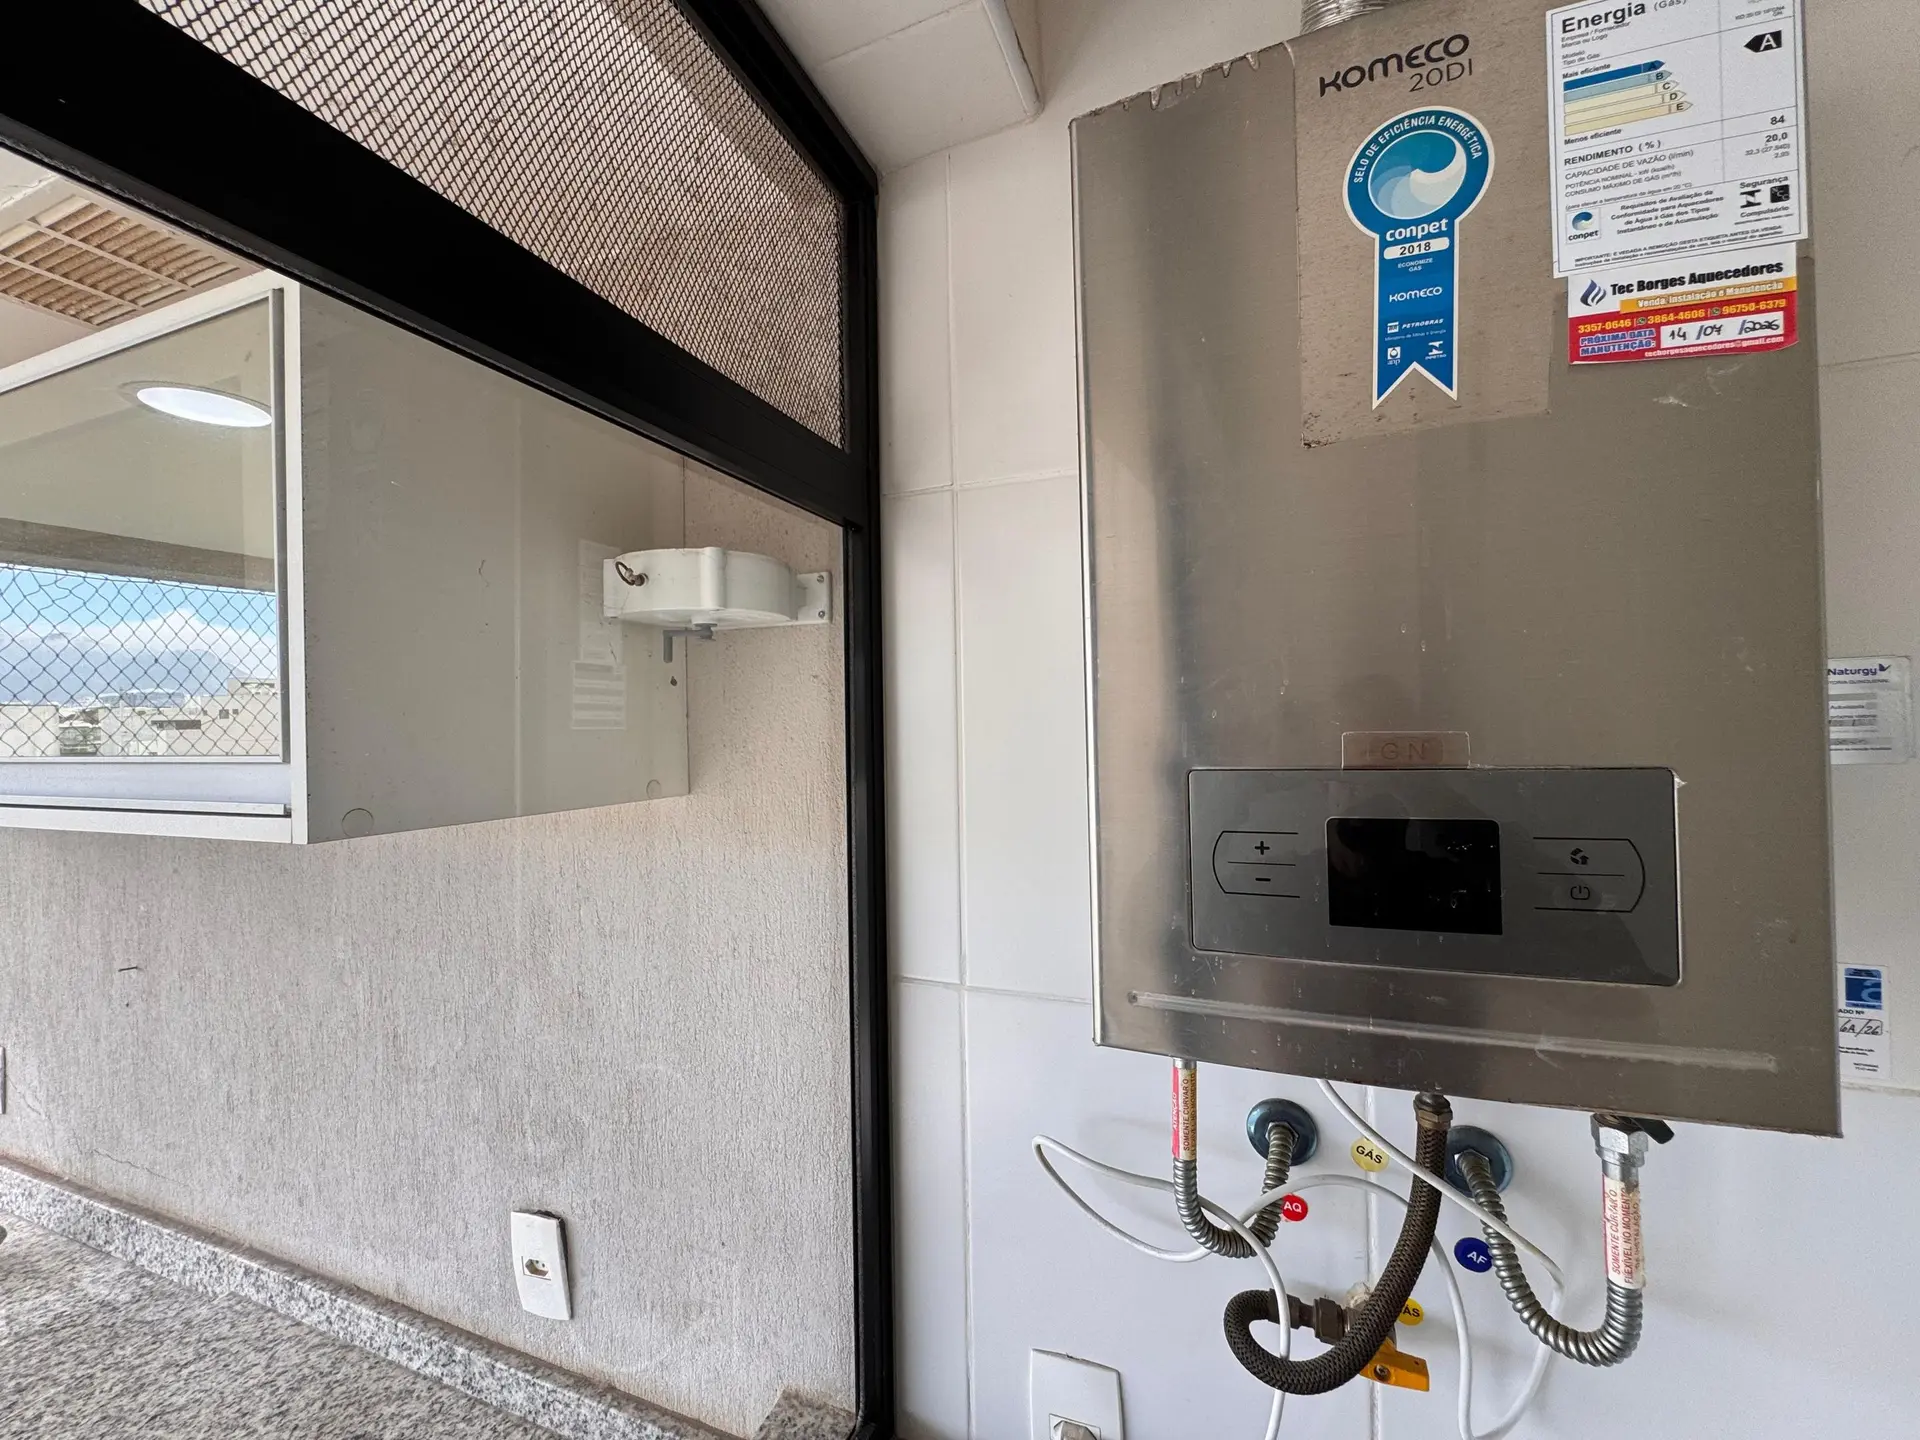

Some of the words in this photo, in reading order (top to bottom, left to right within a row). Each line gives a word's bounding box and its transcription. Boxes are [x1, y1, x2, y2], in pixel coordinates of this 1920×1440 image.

[1562, 3, 1646, 34] Energia
[1592, 33, 1608, 42] Logo
[1759, 34, 1777, 51] A
[1319, 34, 1470, 97] KOMECO
[1562, 70, 1579, 79] Mais
[1580, 63, 1611, 76] eficiente
[1409, 58, 1473, 92] 20DI
[1656, 72, 1664, 80] B
[1662, 82, 1671, 90] C
[1669, 92, 1678, 101] D
[1676, 103, 1684, 111] E
[1770, 115, 1785, 125] 84
[1564, 134, 1589, 145] Menos
[1590, 128, 1621, 140] eficiente
[1354, 159, 1369, 183] SELO
[1366, 143, 1380, 159] DE
[1378, 115, 1436, 144] EFICIÊNCIA
[1438, 116, 1483, 159] ENERGÉTICA
[1564, 145, 1633, 166] RENDIMENTO
[1565, 164, 1620, 180] CAPACIDADE
[1622, 161, 1635, 169] DE
[1636, 153, 1666, 166] VAZÃO
[1565, 178, 1600, 190] POTÊNCIA
[1601, 172, 1633, 183] NOMINAL
[1565, 186, 1601, 198] CONSUMO
[1603, 179, 1631, 190] MÁXIMO
[1645, 174, 1660, 183] GÁS
[1740, 176, 1789, 188] Segurança
[1611, 208, 1659, 221] Conformidade
[1678, 196, 1724, 208] Aquecedores
[1620, 200, 1657, 211] Requisitos
[1669, 191, 1702, 202] Avaliação
[1691, 206, 1710, 215] Tipos
[1740, 205, 1789, 218] Compulsório
[1385, 218, 1448, 242] conpet
[1617, 223, 1657, 235] Instantâneo
[1675, 213, 1719, 224] Acumulação
[1568, 230, 1599, 242] conpet
[1399, 241, 1431, 256] 2018
[1398, 257, 1433, 269] ECONOMIZE
[1610, 282, 1634, 296] Tec
[1637, 275, 1685, 292] Borges
[1688, 261, 1784, 285] Aquecedores
[1389, 286, 1443, 303] KOMECO
[1726, 281, 1784, 295] Manutenção
[1402, 318, 1444, 329] PETROBRAS
[1577, 318, 1631, 333] 3357-0646
[1647, 309, 1705, 325] 3864-4606
[1579, 332, 1628, 346] PRÓXIMA
[1629, 328, 1656, 339] DATA
[1669, 326, 1687, 341] 14
[1579, 339, 1656, 357] MANUTENÇÃO:
[1828, 668, 1877, 676] Naturgy
[1182, 1086, 1190, 1115] CURVAR
[1182, 1116, 1190, 1151] SOMENTE
[1356, 1145, 1383, 1164] GÁS
[1284, 1201, 1302, 1213] AQ
[1622, 1231, 1632, 1244] NO
[1467, 1251, 1487, 1264] AF
[1610, 1233, 1620, 1275] SOMENTE
[1621, 1246, 1633, 1285] FLEXÍVEL
[1402, 1304, 1420, 1317] ÁS
